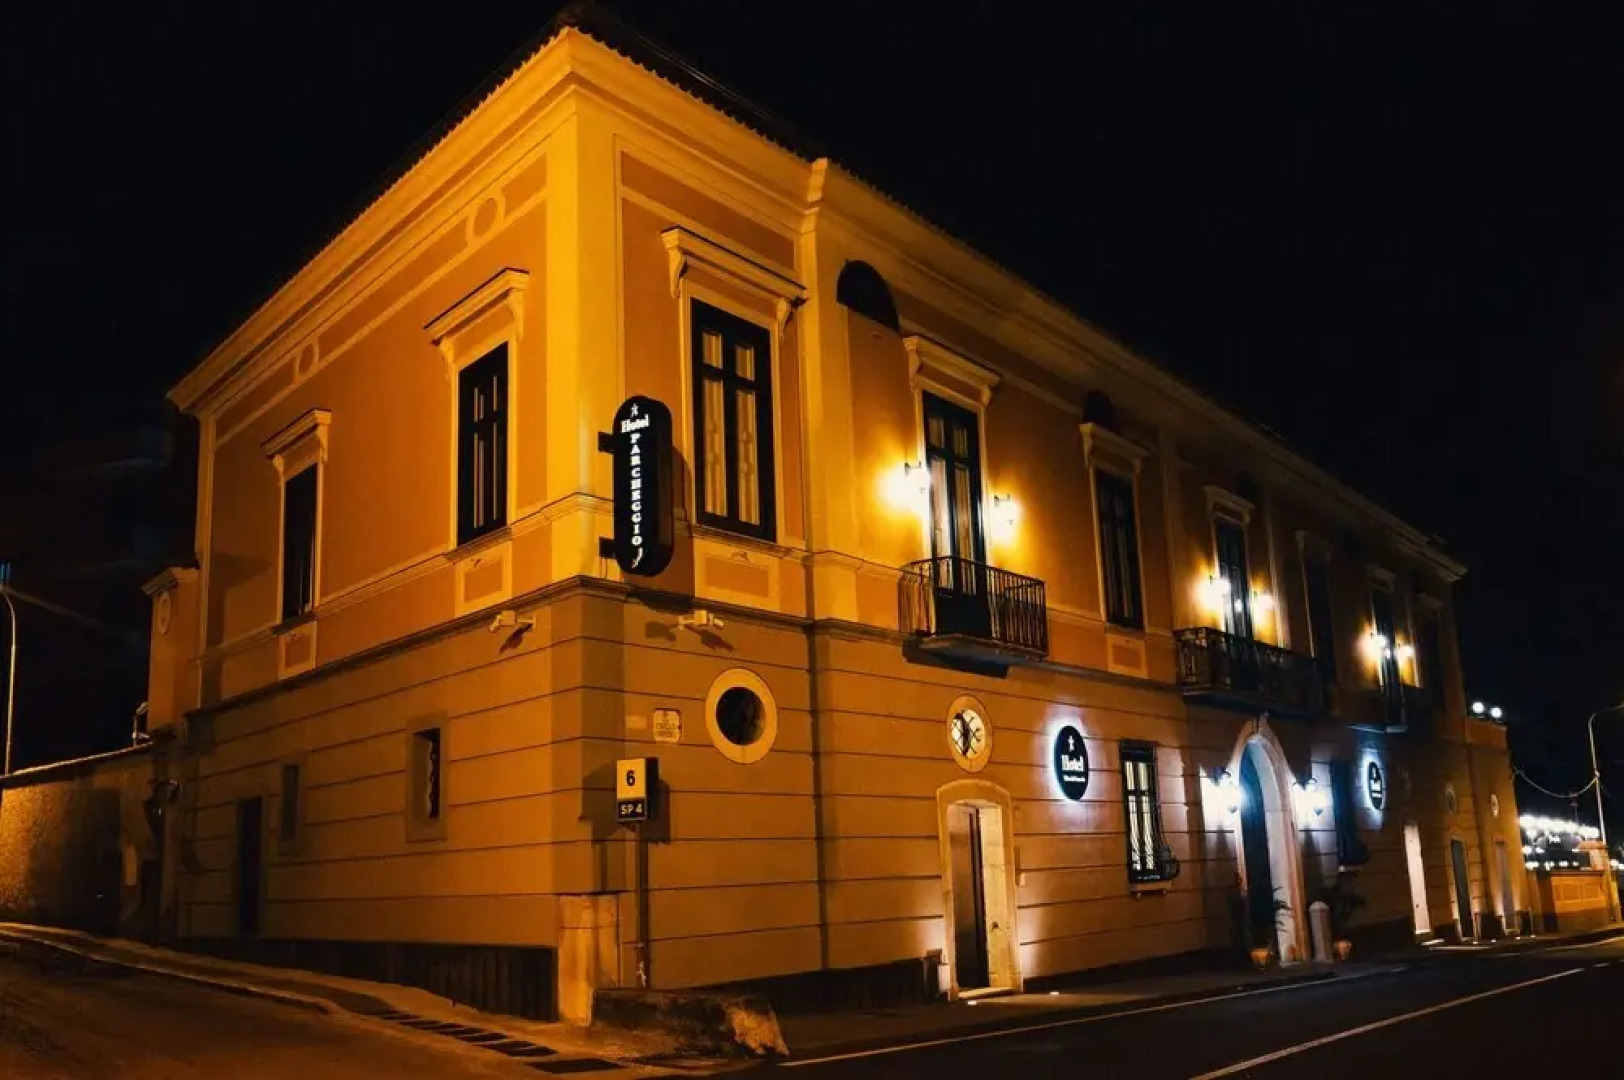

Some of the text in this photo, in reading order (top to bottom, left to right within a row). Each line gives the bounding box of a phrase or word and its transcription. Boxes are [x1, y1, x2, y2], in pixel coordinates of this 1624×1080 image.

[621, 414, 649, 433] Hotel
[630, 432, 643, 546] PARCHEGGIO
[626, 769, 636, 787] 6
[621, 803, 643, 815] SP 4
